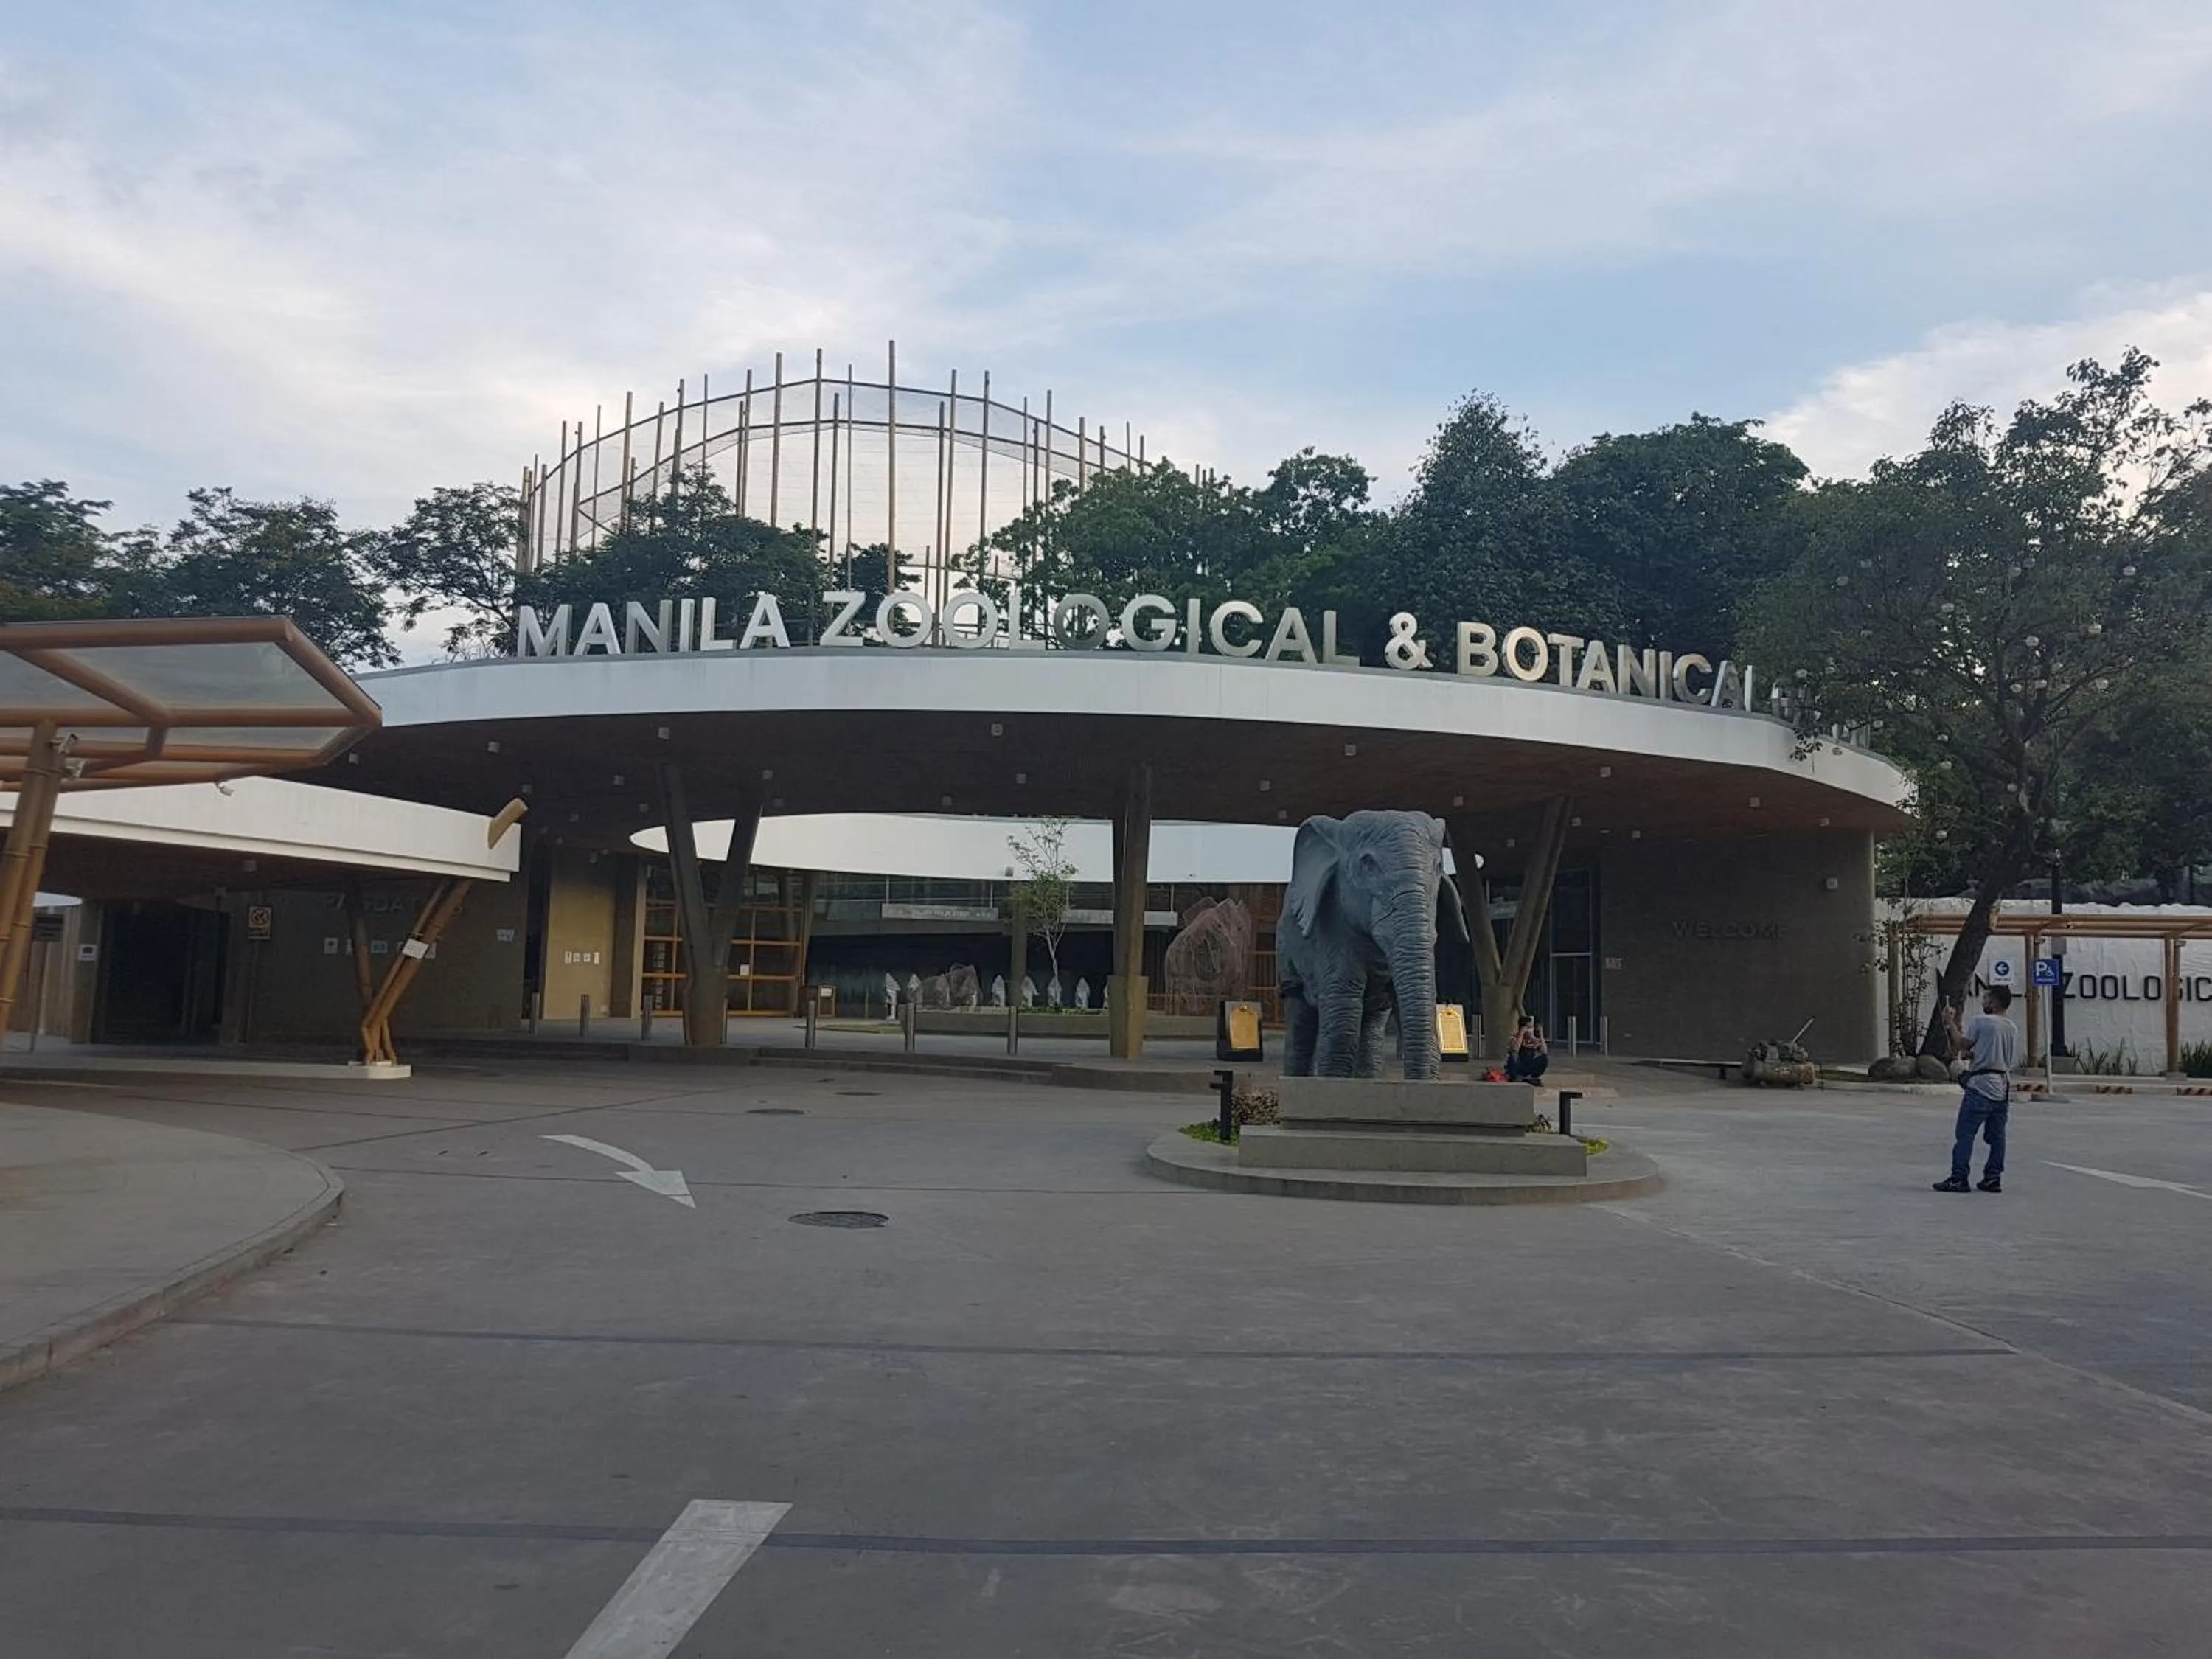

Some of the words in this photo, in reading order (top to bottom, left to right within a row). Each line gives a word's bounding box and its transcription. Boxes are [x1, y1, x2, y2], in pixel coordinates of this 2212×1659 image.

[518, 592, 791, 658] MANILA
[820, 591, 1360, 668] ZOOLOGICAL
[1385, 611, 1433, 670] &
[2062, 971, 2212, 1001] ZOOLOIC
